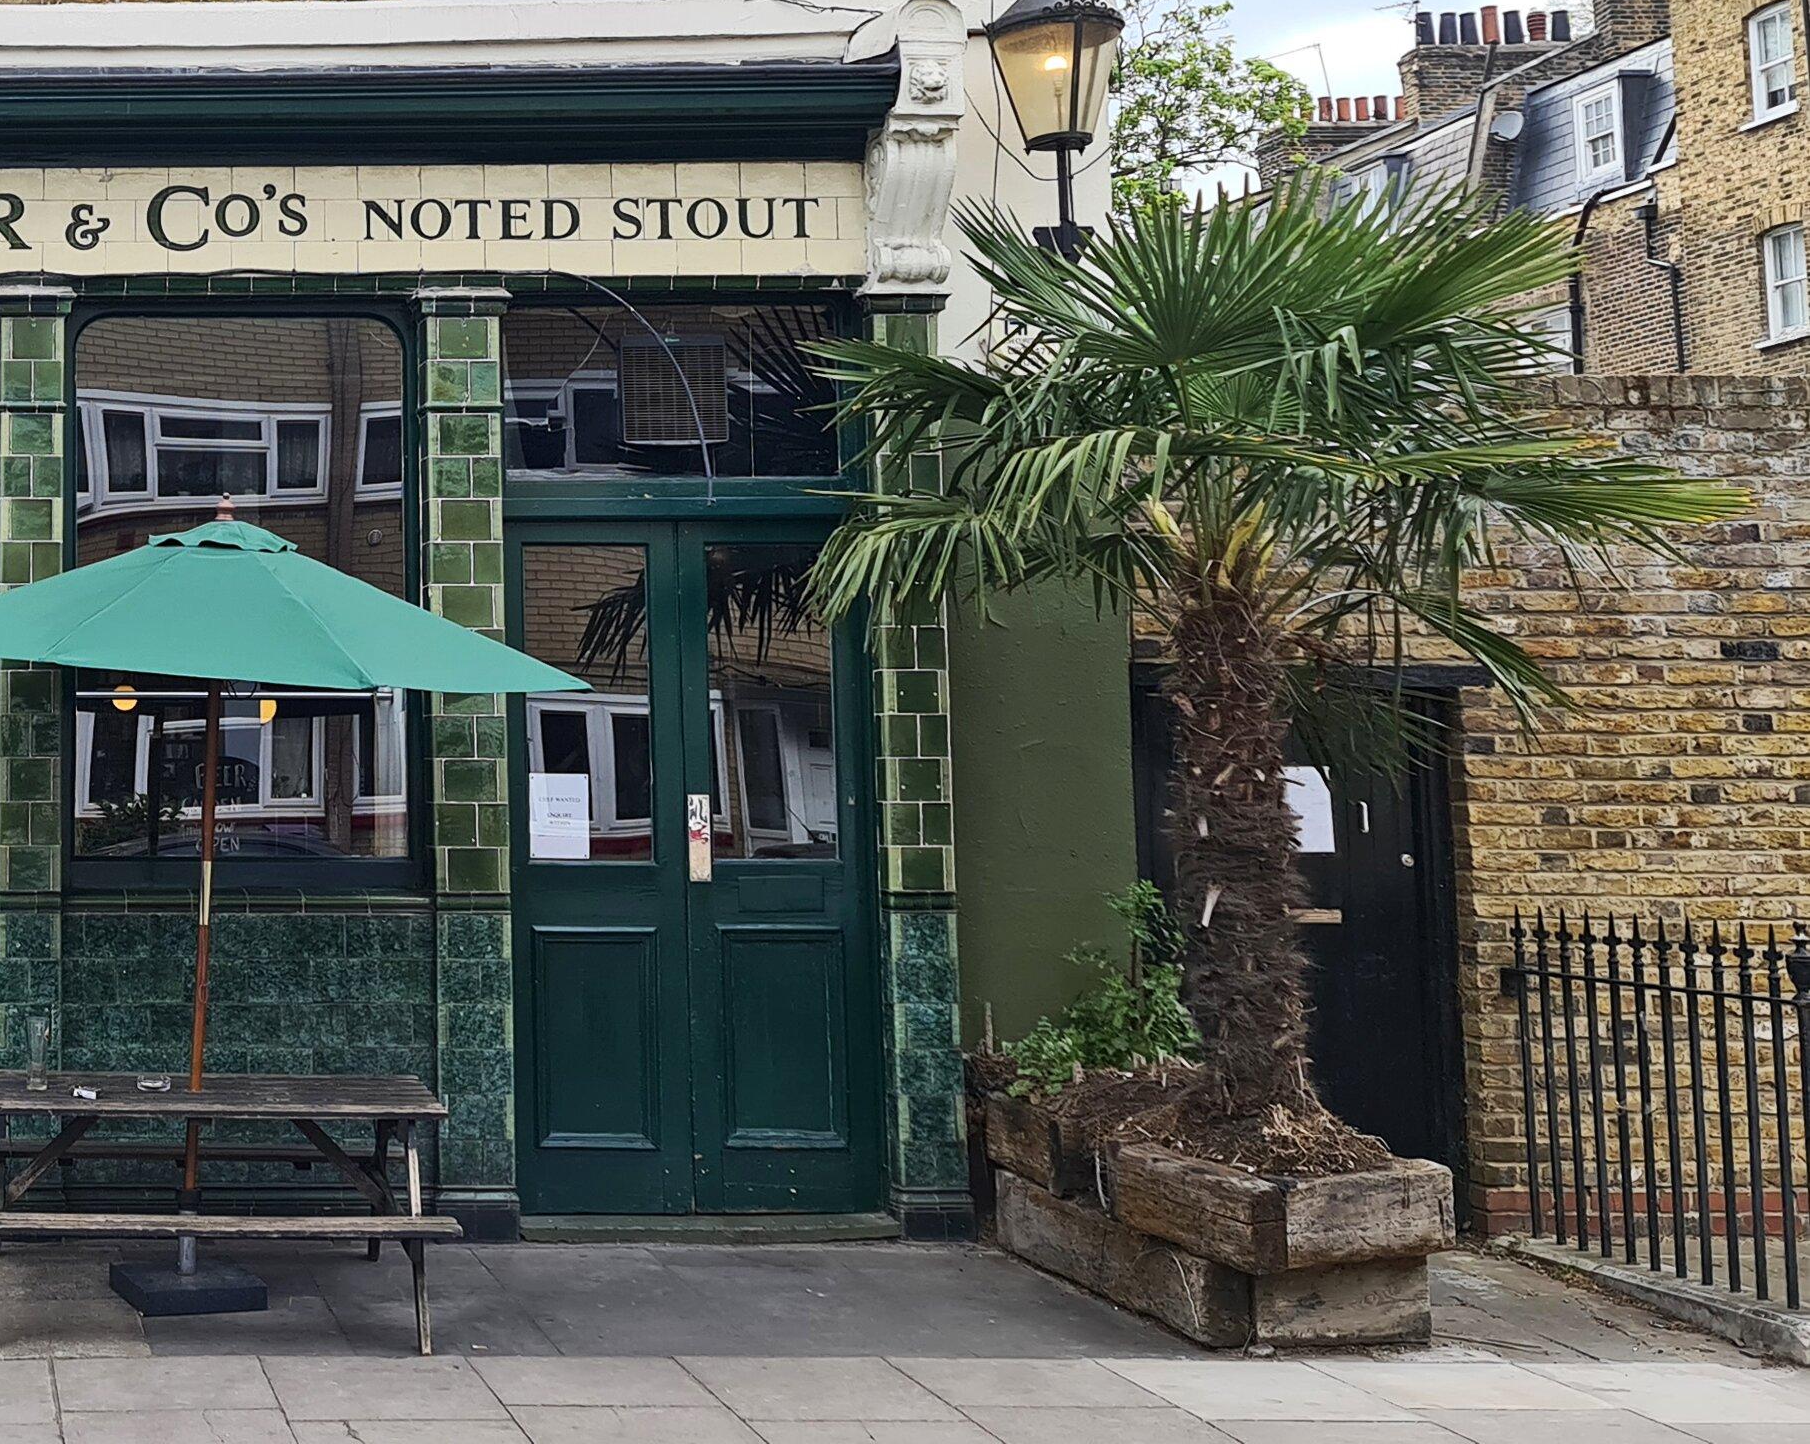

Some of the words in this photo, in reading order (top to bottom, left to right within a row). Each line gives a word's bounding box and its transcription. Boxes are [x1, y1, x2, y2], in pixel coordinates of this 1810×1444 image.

[65, 203, 110, 250] &
[362, 198, 581, 240] NOTED
[612, 197, 820, 240] STOUT
